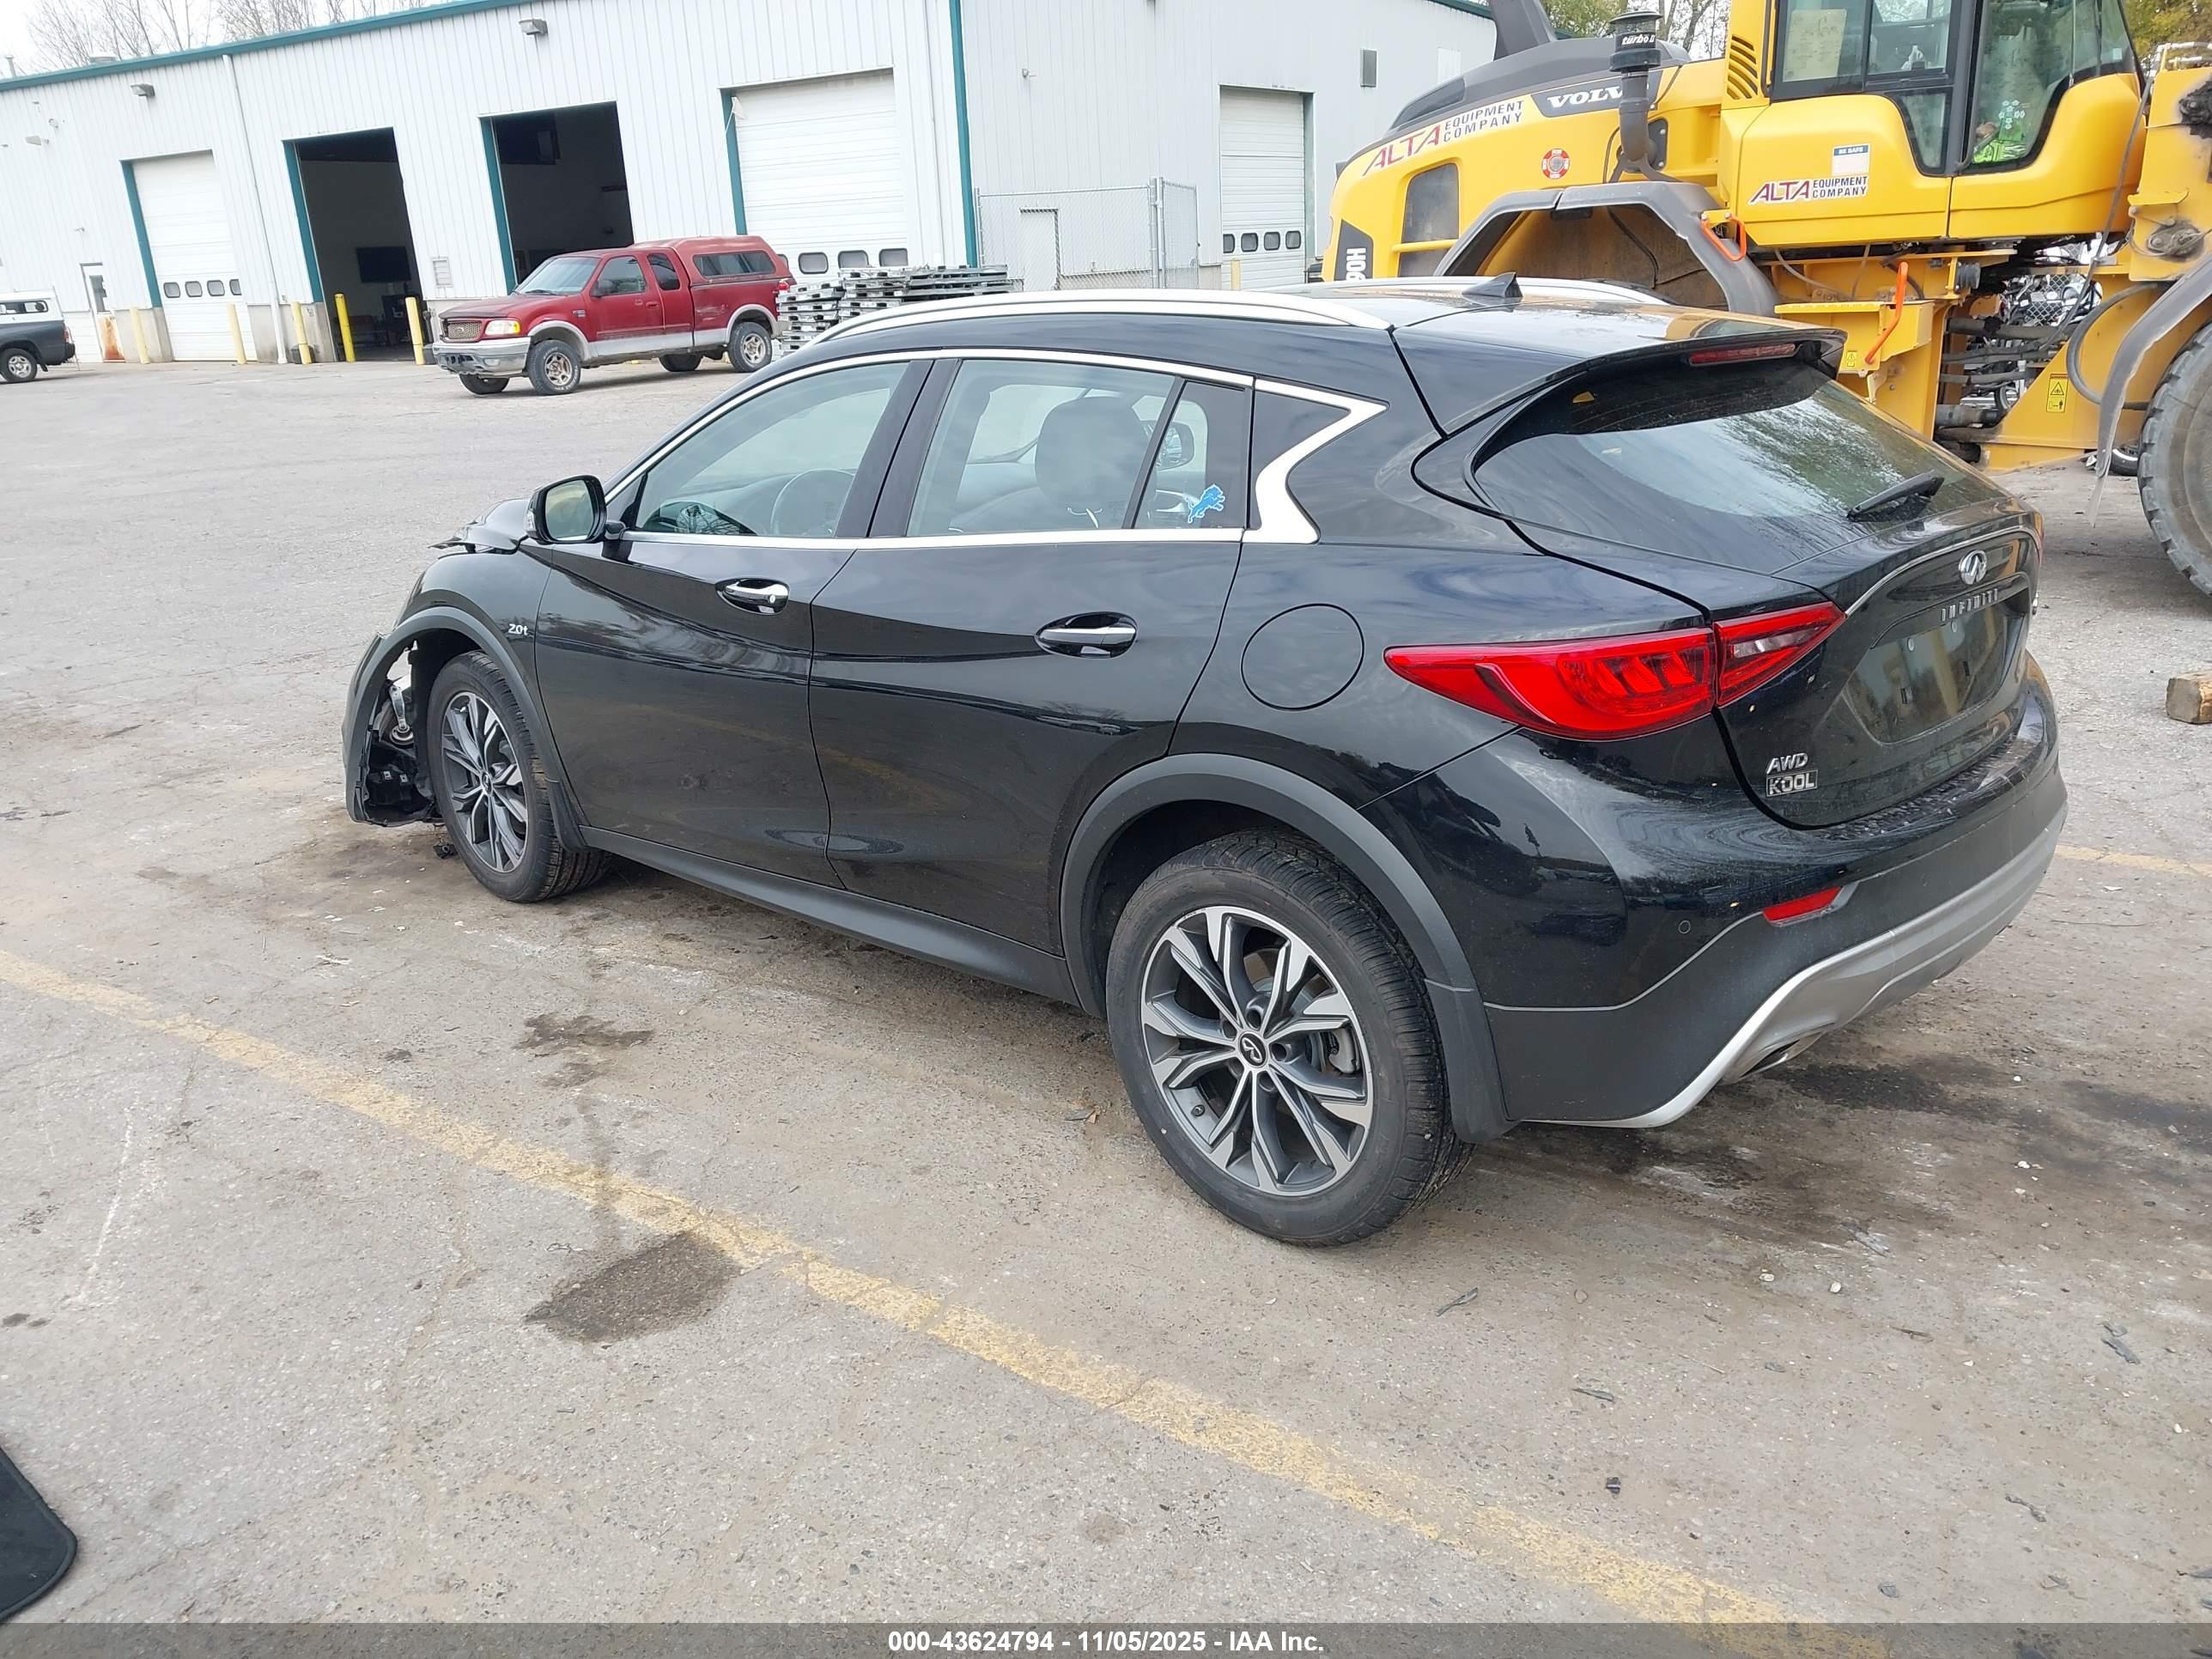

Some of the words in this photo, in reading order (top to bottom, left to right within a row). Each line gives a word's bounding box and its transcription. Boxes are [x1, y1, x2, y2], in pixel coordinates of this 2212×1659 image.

[1547, 86, 1623, 108] VOLV
[1444, 100, 1524, 131] EQUIPMENT
[1443, 112, 1522, 143] COMPANY
[1362, 125, 1441, 176] ALTA
[1751, 180, 1810, 203] ALTA
[1812, 186, 1867, 198] COMPANY
[1813, 176, 1868, 188] EQUIPMENT
[1942, 588, 1998, 622] INFINITI
[1766, 752, 1808, 775] AWD
[1769, 773, 1815, 795] KOOL
